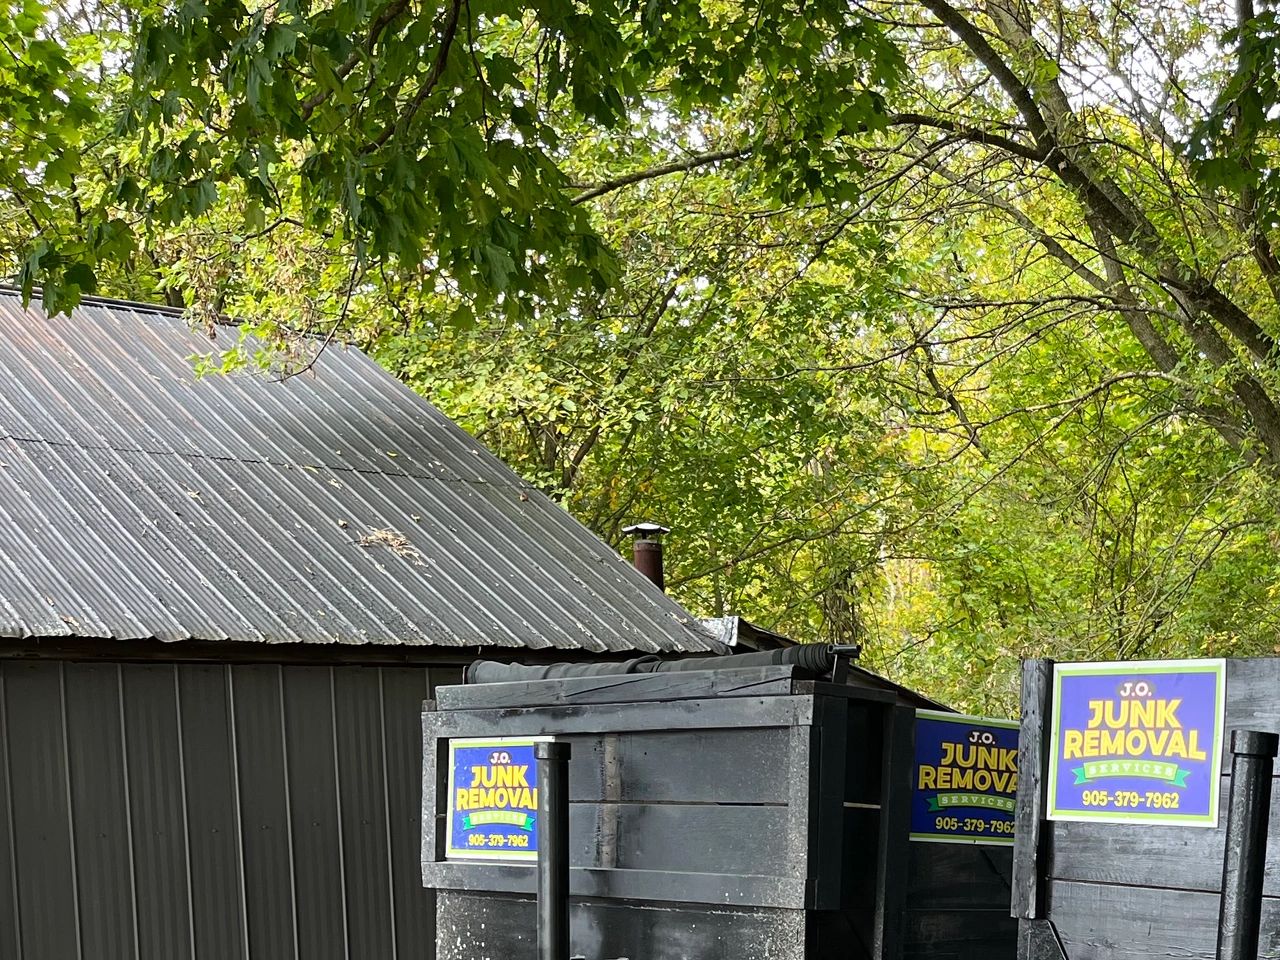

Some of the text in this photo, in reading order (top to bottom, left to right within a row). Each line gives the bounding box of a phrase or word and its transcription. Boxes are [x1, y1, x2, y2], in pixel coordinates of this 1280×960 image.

[1120, 681, 1152, 697] J.O.
[1087, 698, 1183, 729] JUNK
[969, 731, 996, 745] J.O.
[1063, 729, 1207, 761] REMOVAL
[490, 752, 511, 764] J.O.
[941, 742, 1018, 772] JUNK
[471, 765, 529, 788] JUNK
[1088, 762, 1173, 777] SERVICES
[918, 765, 1018, 794] REMOVA
[941, 795, 1012, 809] SERVICES
[1082, 790, 1180, 809] 905-379-7962
[935, 816, 1016, 834] 905-379-7962
[468, 834, 529, 847] 905-379-7962
